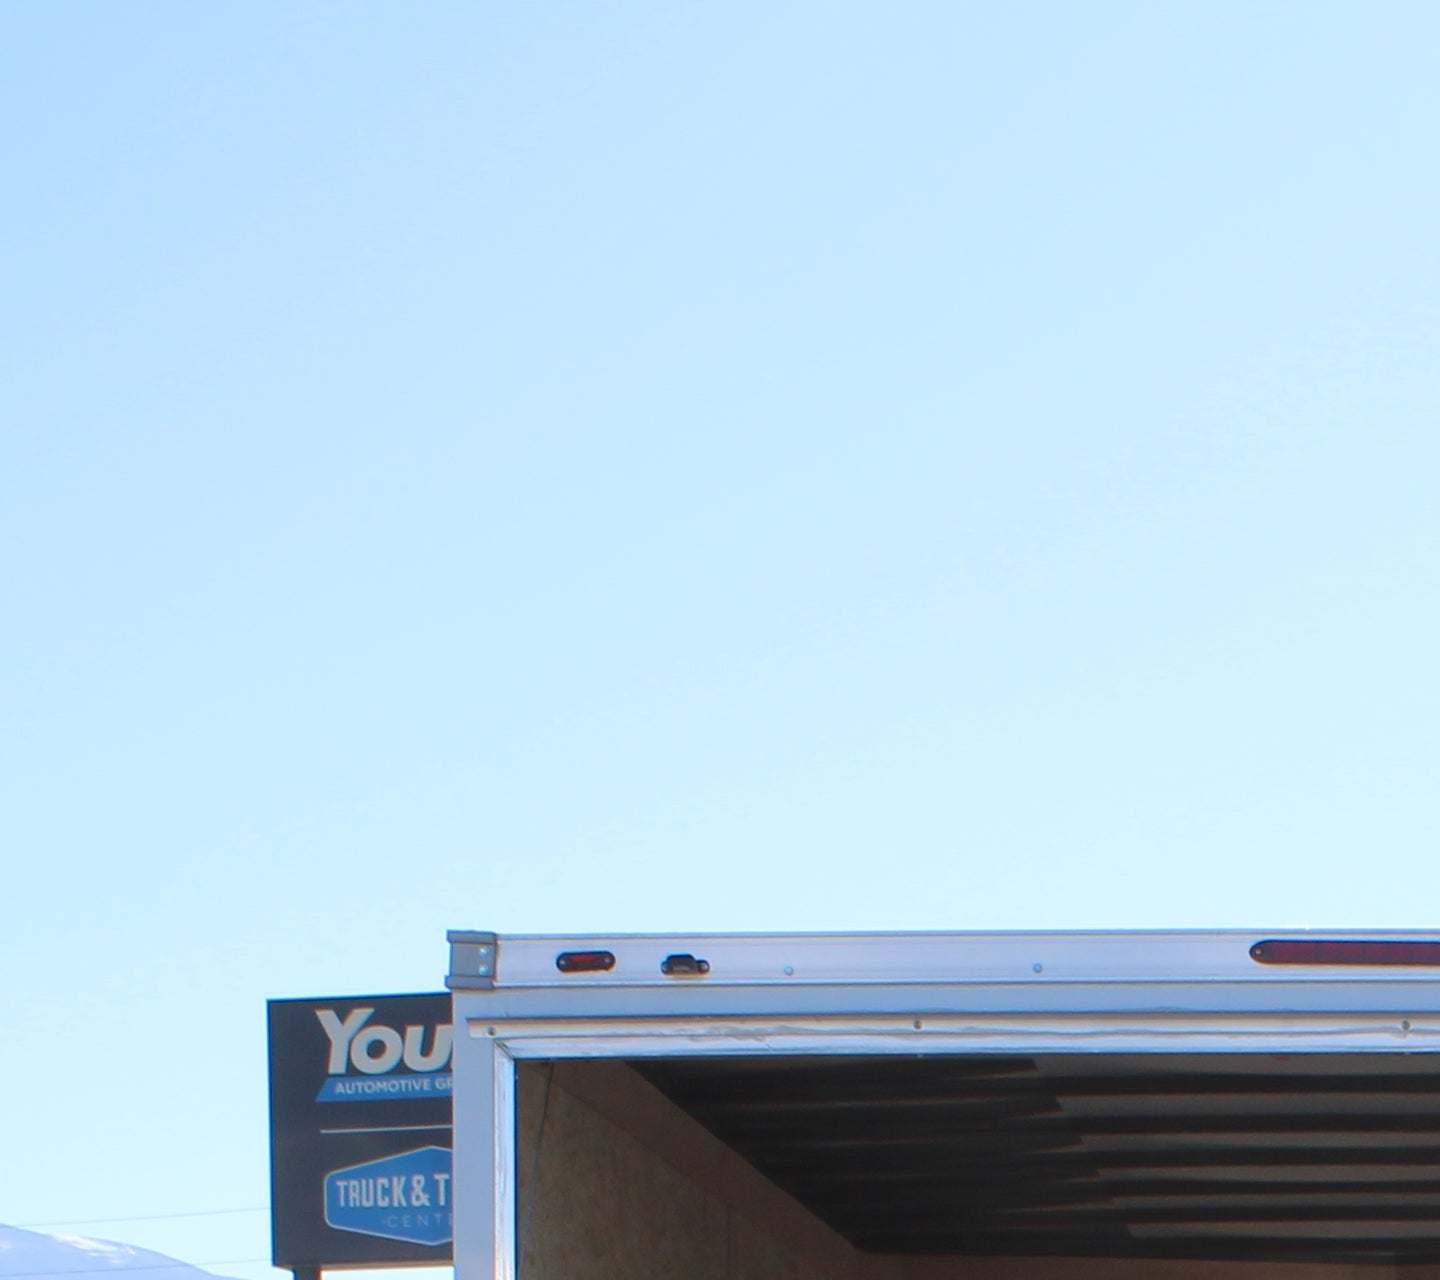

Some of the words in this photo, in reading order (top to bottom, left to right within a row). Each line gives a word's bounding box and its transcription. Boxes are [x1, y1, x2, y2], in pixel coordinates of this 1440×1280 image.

[335, 1079, 431, 1095] AUTOMOTIVE
[336, 1176, 408, 1208] TRUCK
[410, 1174, 430, 1207] &
